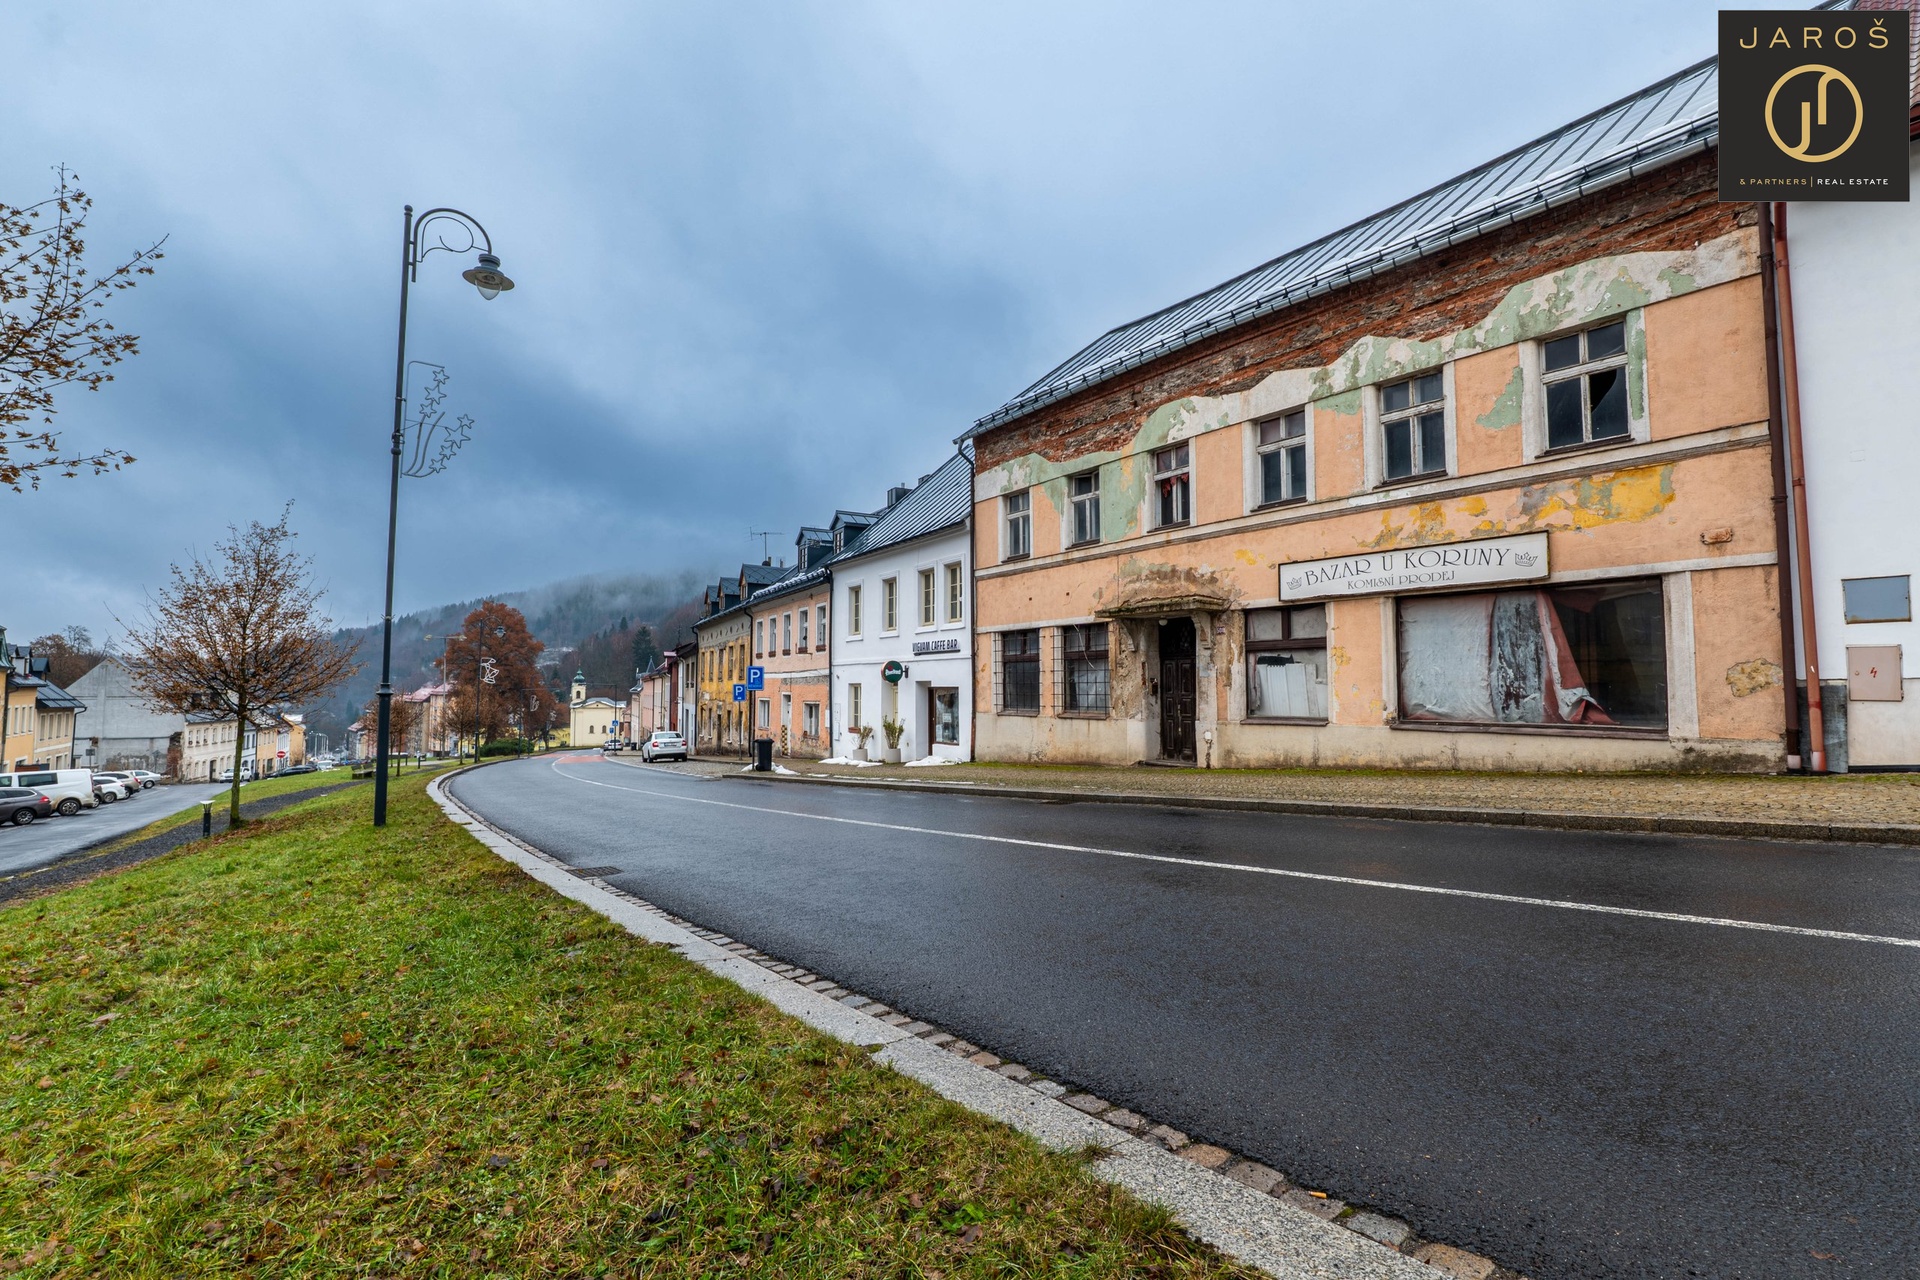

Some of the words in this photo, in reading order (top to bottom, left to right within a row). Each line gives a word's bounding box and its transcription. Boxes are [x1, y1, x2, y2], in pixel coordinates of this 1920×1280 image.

[1304, 559, 1372, 586] BAZAR
[1382, 554, 1394, 571] U
[1404, 548, 1511, 569] KORUNY
[1347, 573, 1394, 590] KOMISNÍ
[1398, 570, 1455, 585] PRODEJ
[946, 638, 958, 650] BAR
[750, 669, 761, 683] P
[735, 685, 743, 696] P
